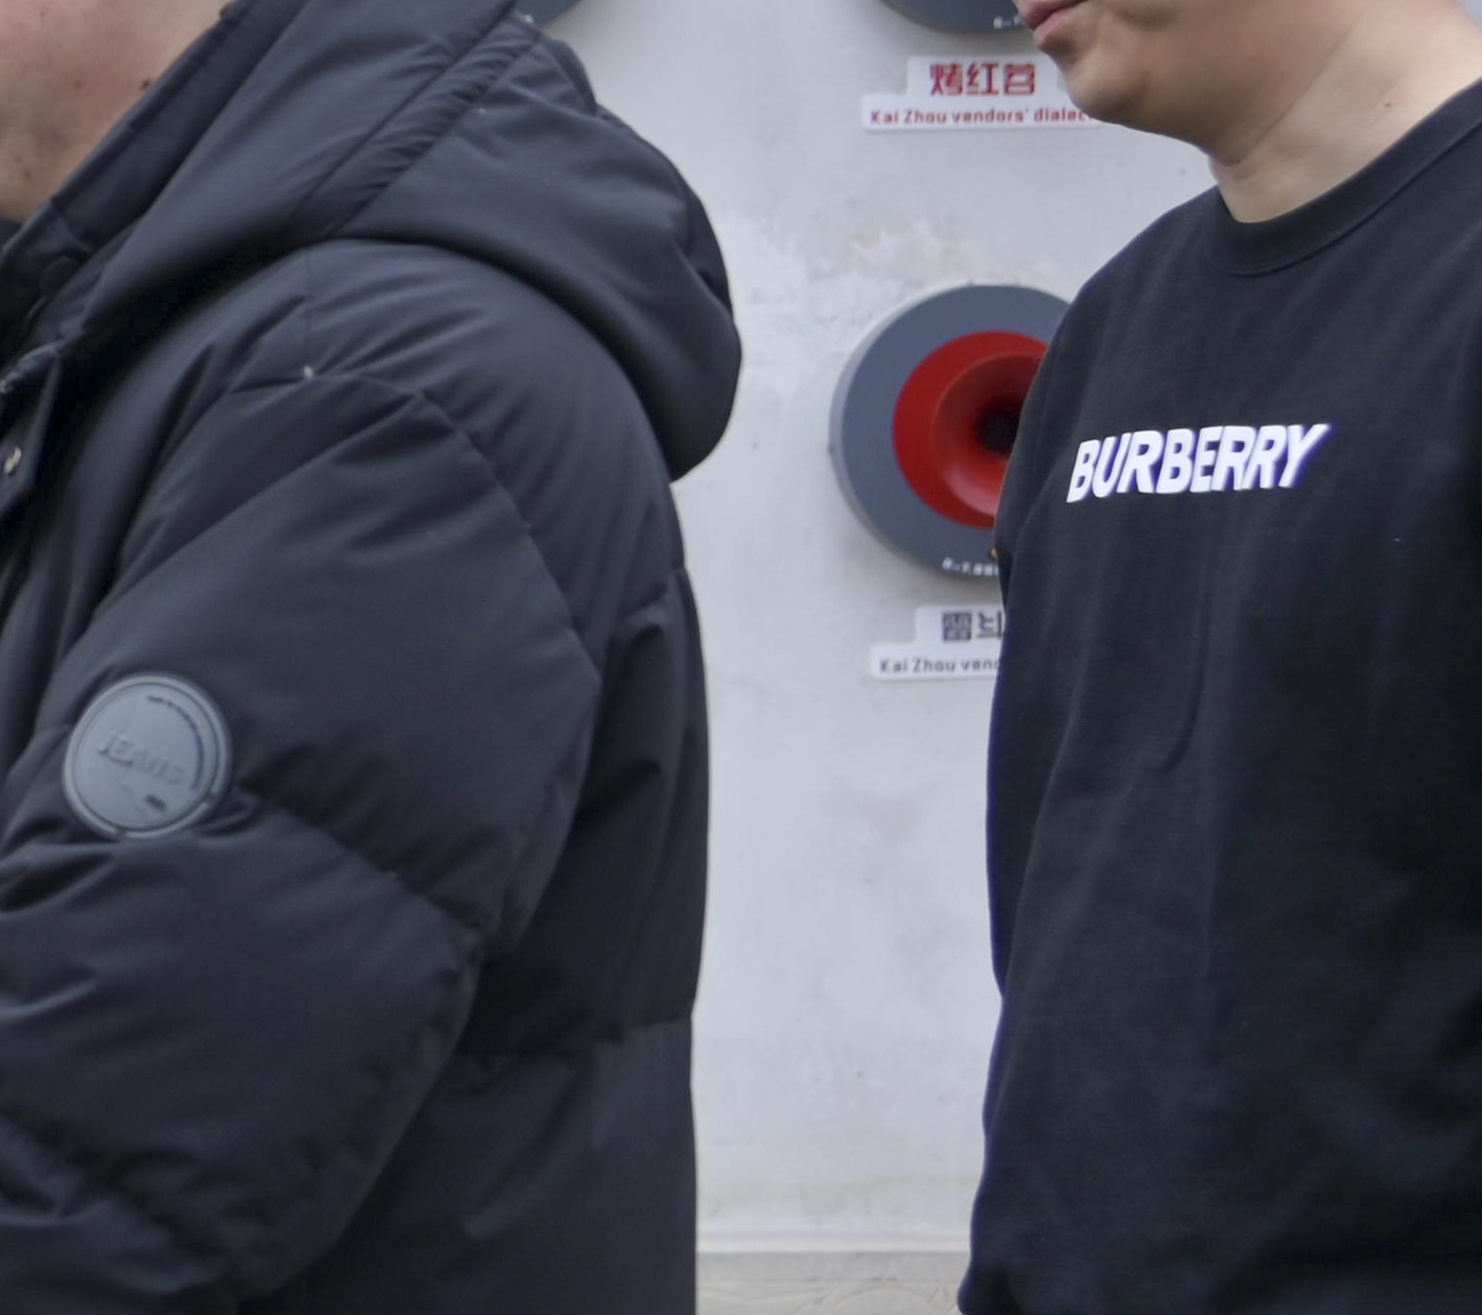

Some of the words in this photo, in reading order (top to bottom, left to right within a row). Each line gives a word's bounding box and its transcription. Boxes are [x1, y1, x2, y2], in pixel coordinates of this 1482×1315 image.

[870, 110, 899, 125] Kai
[904, 109, 947, 125] Zhou
[1066, 423, 1330, 504] BURBERRY
[912, 658, 955, 673] Zhou
